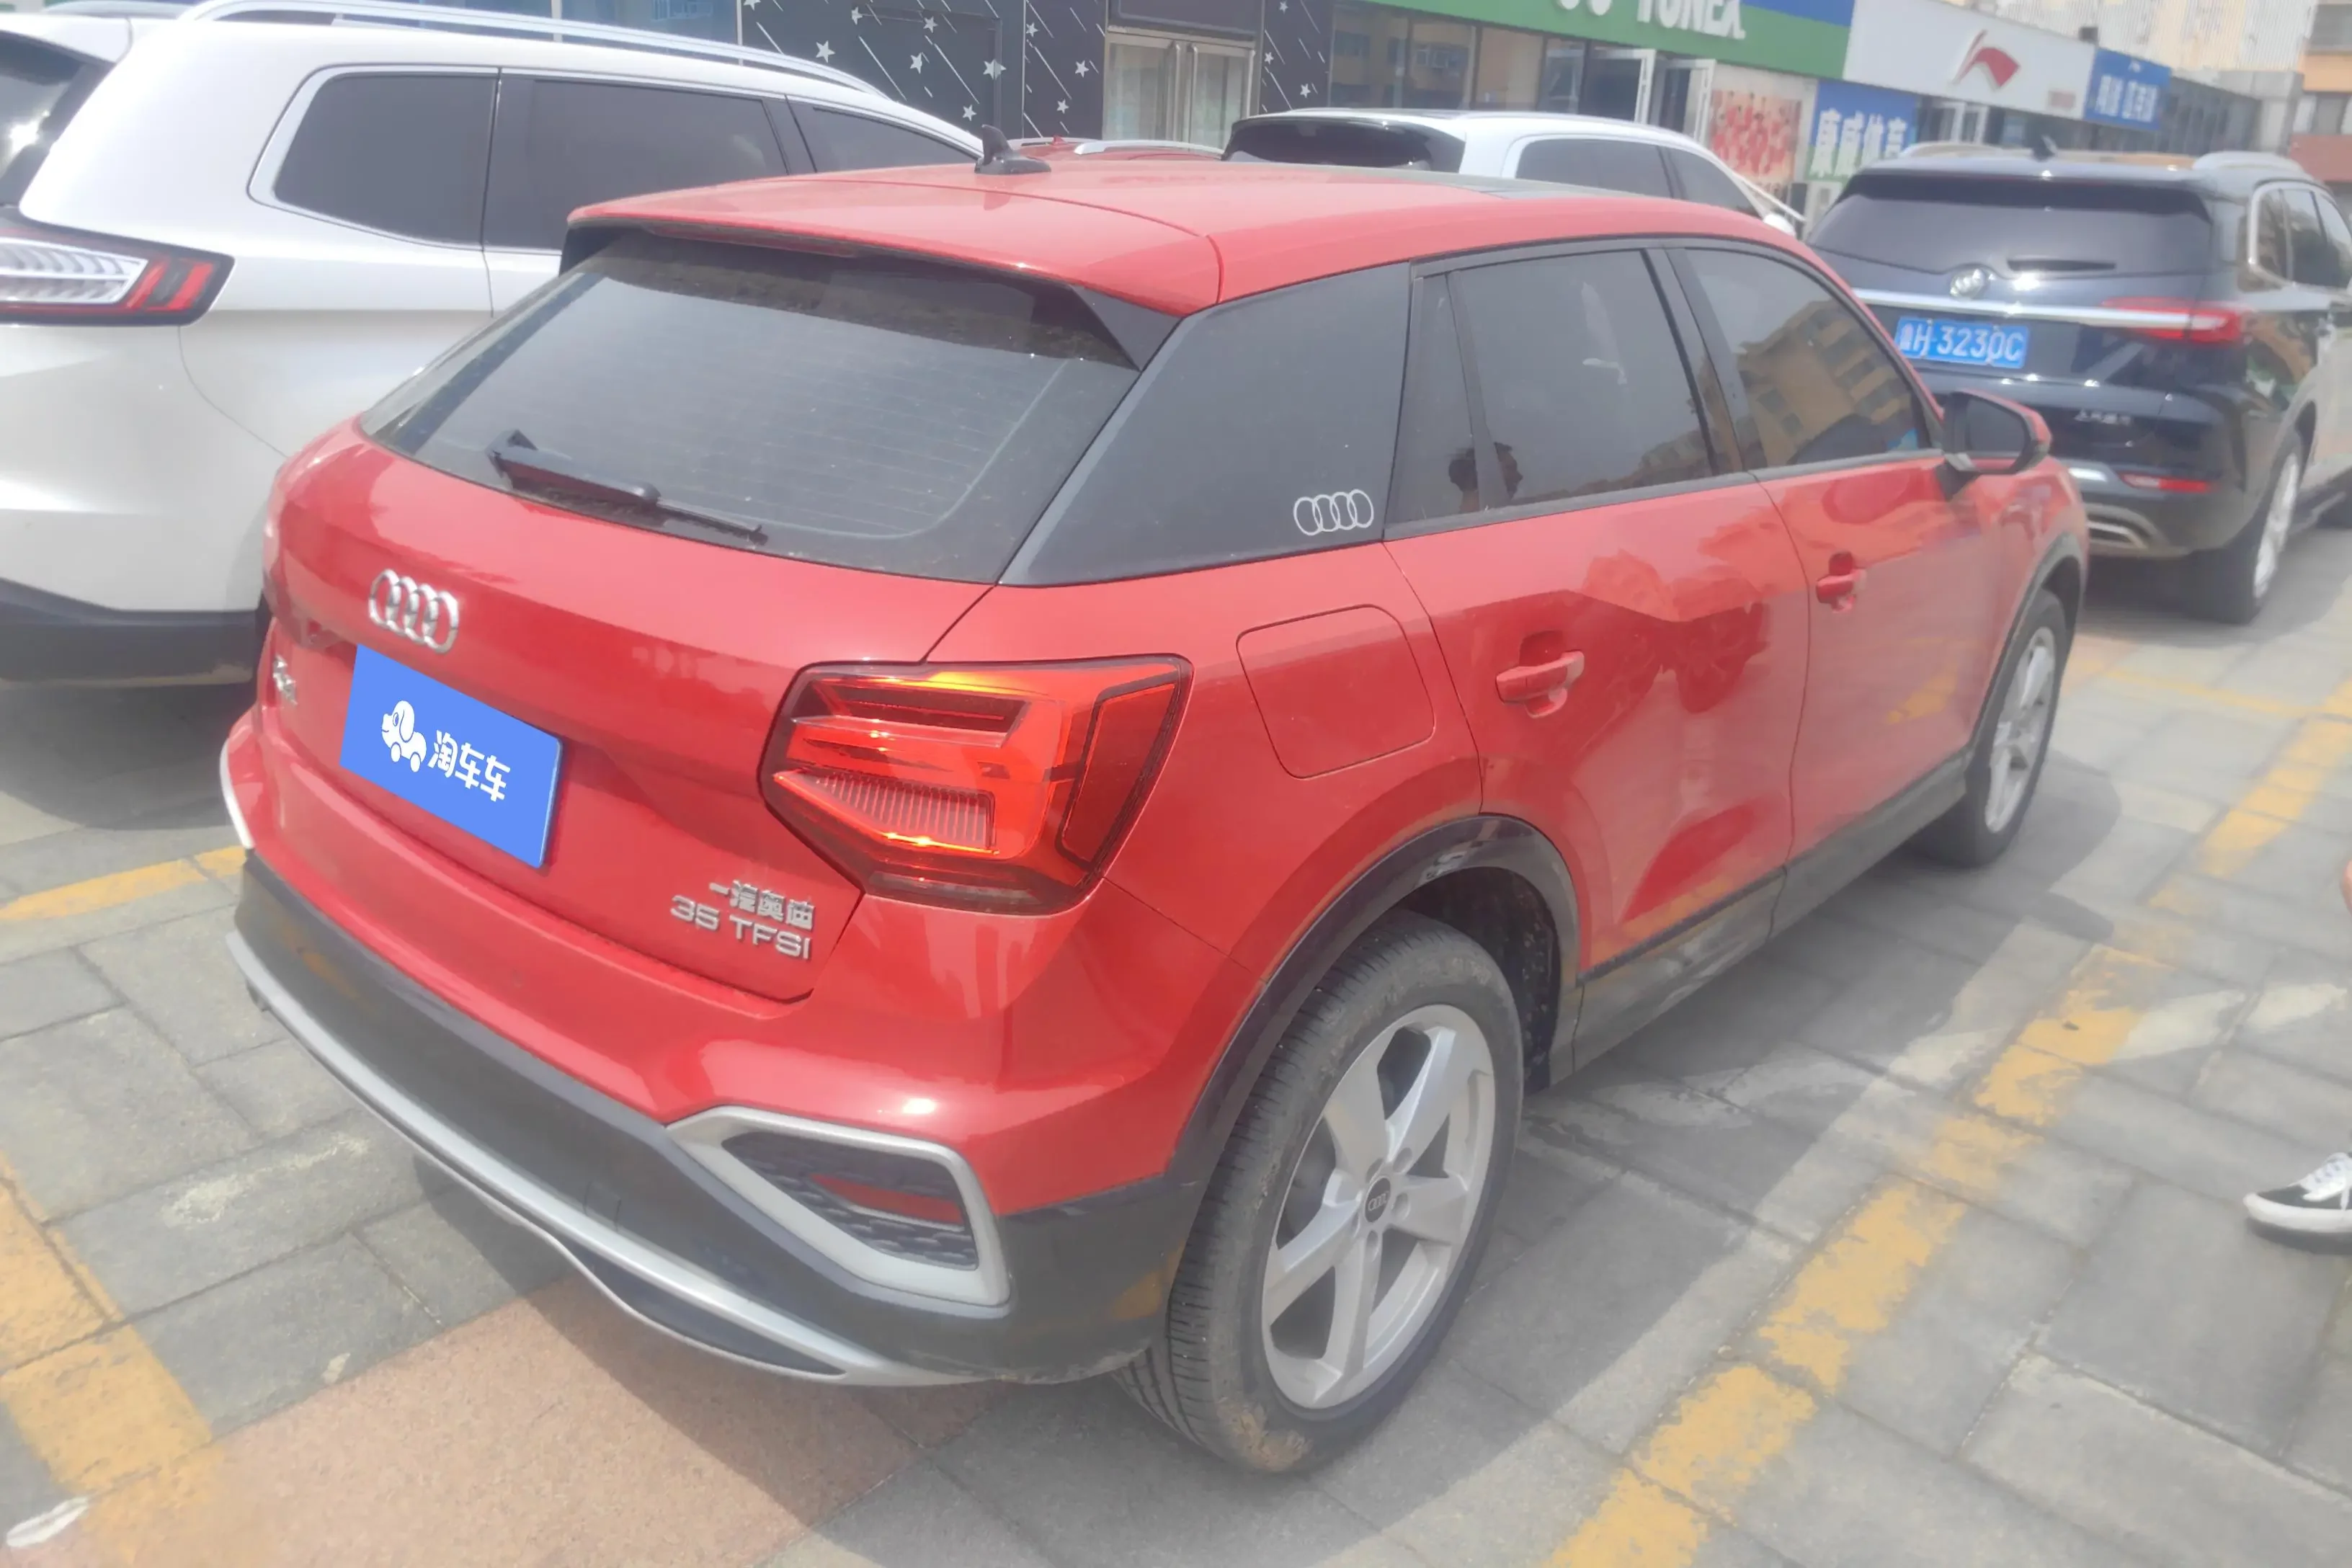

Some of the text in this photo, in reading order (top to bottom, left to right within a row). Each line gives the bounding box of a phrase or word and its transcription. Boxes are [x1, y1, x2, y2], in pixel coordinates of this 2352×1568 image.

[670, 894, 811, 959] 35 TFSI
[709, 879, 815, 931] 一汽奥迪
